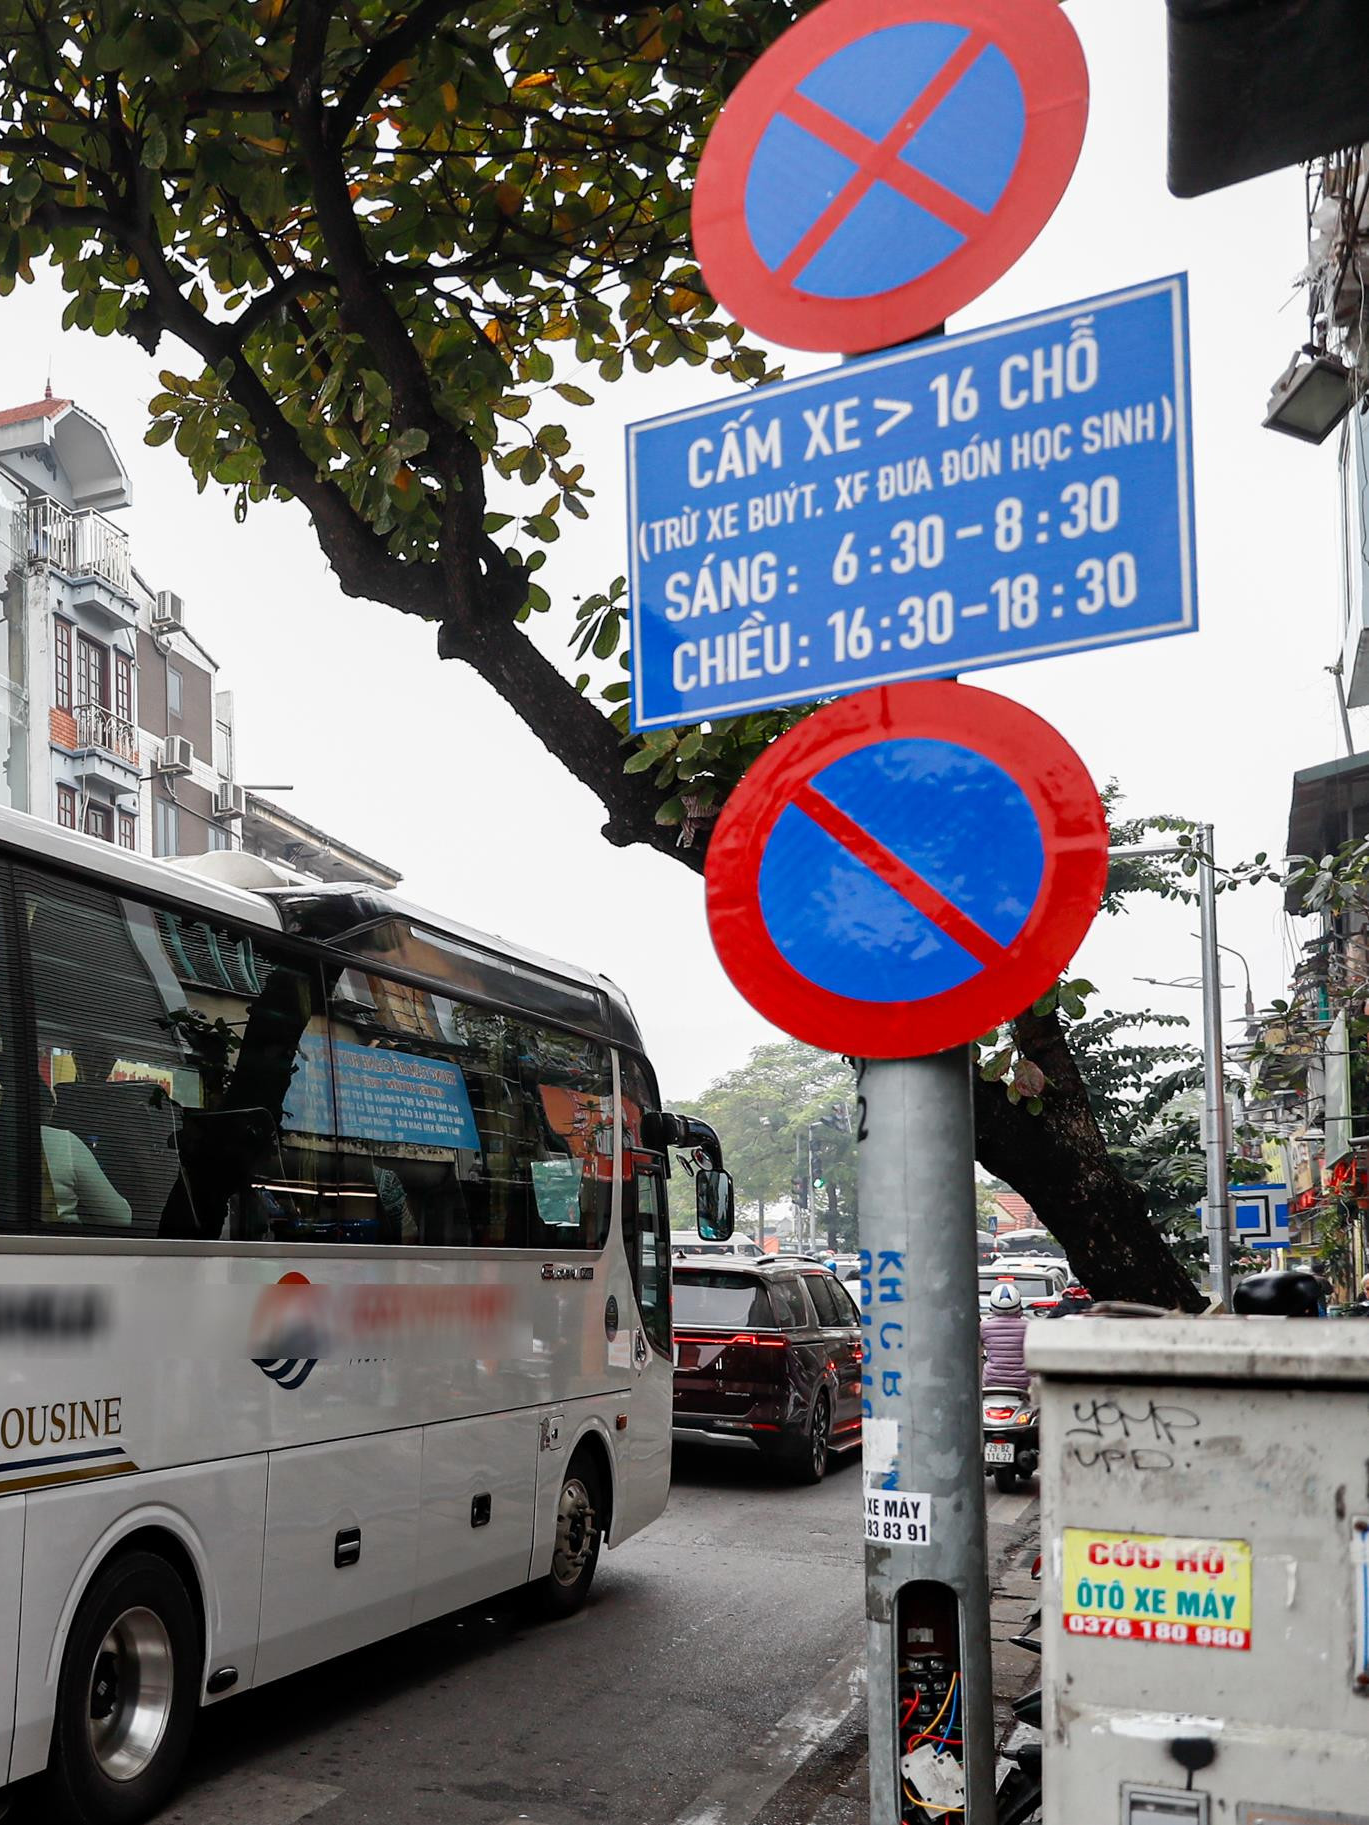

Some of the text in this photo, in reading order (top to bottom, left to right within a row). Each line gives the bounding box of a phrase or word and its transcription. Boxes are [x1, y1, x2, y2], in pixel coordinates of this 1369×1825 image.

[688, 409, 782, 489] CẤM
[803, 396, 862, 461] XE
[929, 367, 979, 428] 16
[999, 315, 1099, 411] CHỖ
[706, 503, 740, 543] XE
[876, 456, 933, 502] ĐƯA
[940, 432, 1001, 487] ĐÓN
[1011, 423, 1072, 471] HỌC
[867, 1498, 879, 1515] XE
[884, 1497, 921, 1519] MÁY
[868, 1520, 927, 1541] 83 83 91
[1077, 1577, 1235, 1620] ÔTÔ XE MÁY
[1069, 1615, 1245, 1648] 0376 180 980
